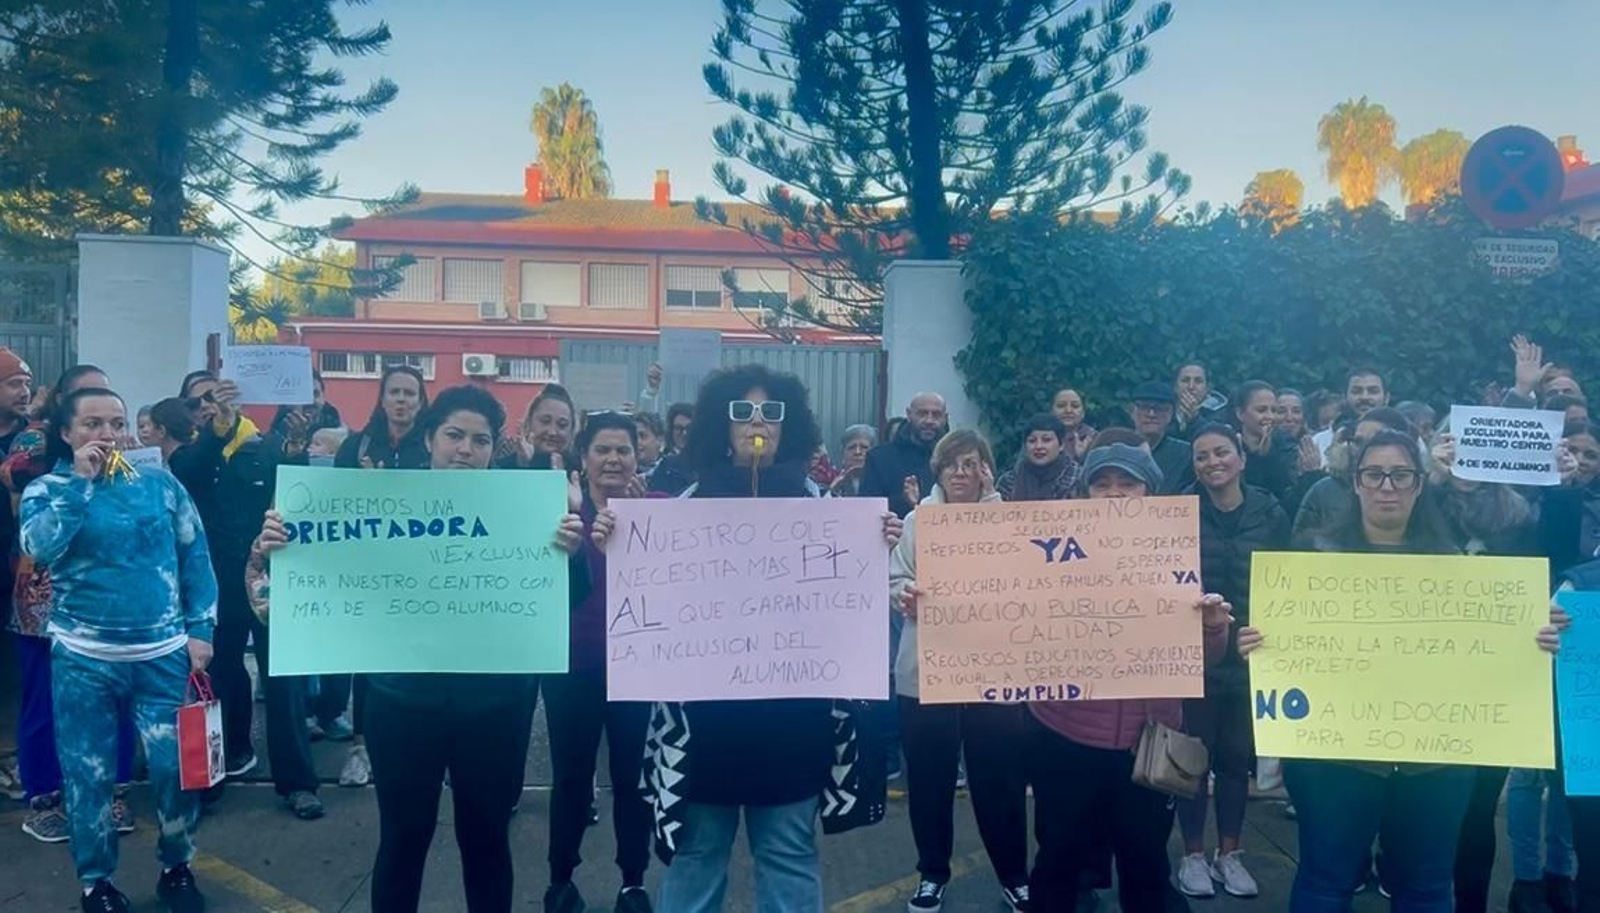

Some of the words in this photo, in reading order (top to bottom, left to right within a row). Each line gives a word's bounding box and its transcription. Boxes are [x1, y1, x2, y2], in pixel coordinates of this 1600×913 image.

[1494, 254, 1547, 266] EXCLUSIVO
[1464, 427, 1520, 439] EXCLUSIVA
[1522, 430, 1551, 441] PARA
[1470, 417, 1544, 430] ORIENTADORA
[1460, 437, 1509, 450] NUESTRO
[1510, 440, 1553, 452] CENTRO
[1466, 459, 1480, 468] DE
[1482, 460, 1499, 470] 500
[1500, 461, 1551, 473] ALUMNOS
[286, 481, 413, 515] QUEREMOS
[424, 499, 454, 516] UNA
[1032, 508, 1100, 523] EDUCATIVA
[1107, 496, 1144, 519] NO
[1148, 505, 1191, 520] PUEDE
[283, 516, 489, 544] ORIENTADORA
[626, 514, 756, 554] NUESTRO
[769, 519, 840, 543] COLE
[1012, 524, 1067, 537] SEGUIR
[1030, 536, 1088, 563] YA
[1099, 536, 1124, 549] NO
[1132, 536, 1198, 550] PODEMOS
[1116, 553, 1185, 570] ESPERAR
[288, 571, 327, 590] PARA
[338, 573, 418, 591] NUESTRO
[428, 575, 510, 591] CENTRO
[519, 576, 554, 590] CON
[615, 558, 740, 590] NECESITA
[856, 558, 869, 579] Y
[1012, 577, 1021, 590] A
[1027, 576, 1053, 590] LAS
[1060, 573, 1113, 590] FAMILIAS
[1172, 569, 1199, 584] YA
[1264, 566, 1292, 591] UN
[1307, 575, 1407, 595] DOCENTE
[1418, 578, 1456, 597] QUE
[1463, 579, 1527, 601] CUBRE
[292, 600, 334, 618] MAS
[344, 601, 365, 616] DE
[385, 599, 441, 615] 500
[447, 600, 538, 617] ALUMNOS
[609, 594, 662, 633] AL
[678, 601, 724, 624] QUE
[739, 591, 872, 617] GARANTICEN
[1047, 597, 1141, 617] PUBLICA
[1156, 598, 1178, 616] DE
[1353, 600, 1378, 620] ES
[1009, 620, 1124, 644] CALIDAD
[611, 644, 638, 662] LA
[652, 635, 758, 660] INCLUSION
[774, 631, 822, 651] DEL
[1357, 637, 1381, 652] LA
[1394, 636, 1456, 655] PLAZA
[1468, 639, 1496, 655] AL
[923, 648, 1018, 668] RECURSOS
[1024, 647, 1115, 665] EDUCATIVOS
[729, 659, 841, 685] ALUMNADO
[950, 671, 997, 686] IGUAL
[1003, 671, 1013, 683] A
[1024, 665, 1103, 682] DERECHOS
[1256, 687, 1310, 721] NO
[1320, 701, 1336, 721] A
[1351, 702, 1382, 721] UN
[1393, 700, 1511, 725] DOCENTE
[1296, 728, 1345, 747] PARA
[1365, 729, 1405, 750] 50
[1414, 734, 1474, 755] NIÑOS
